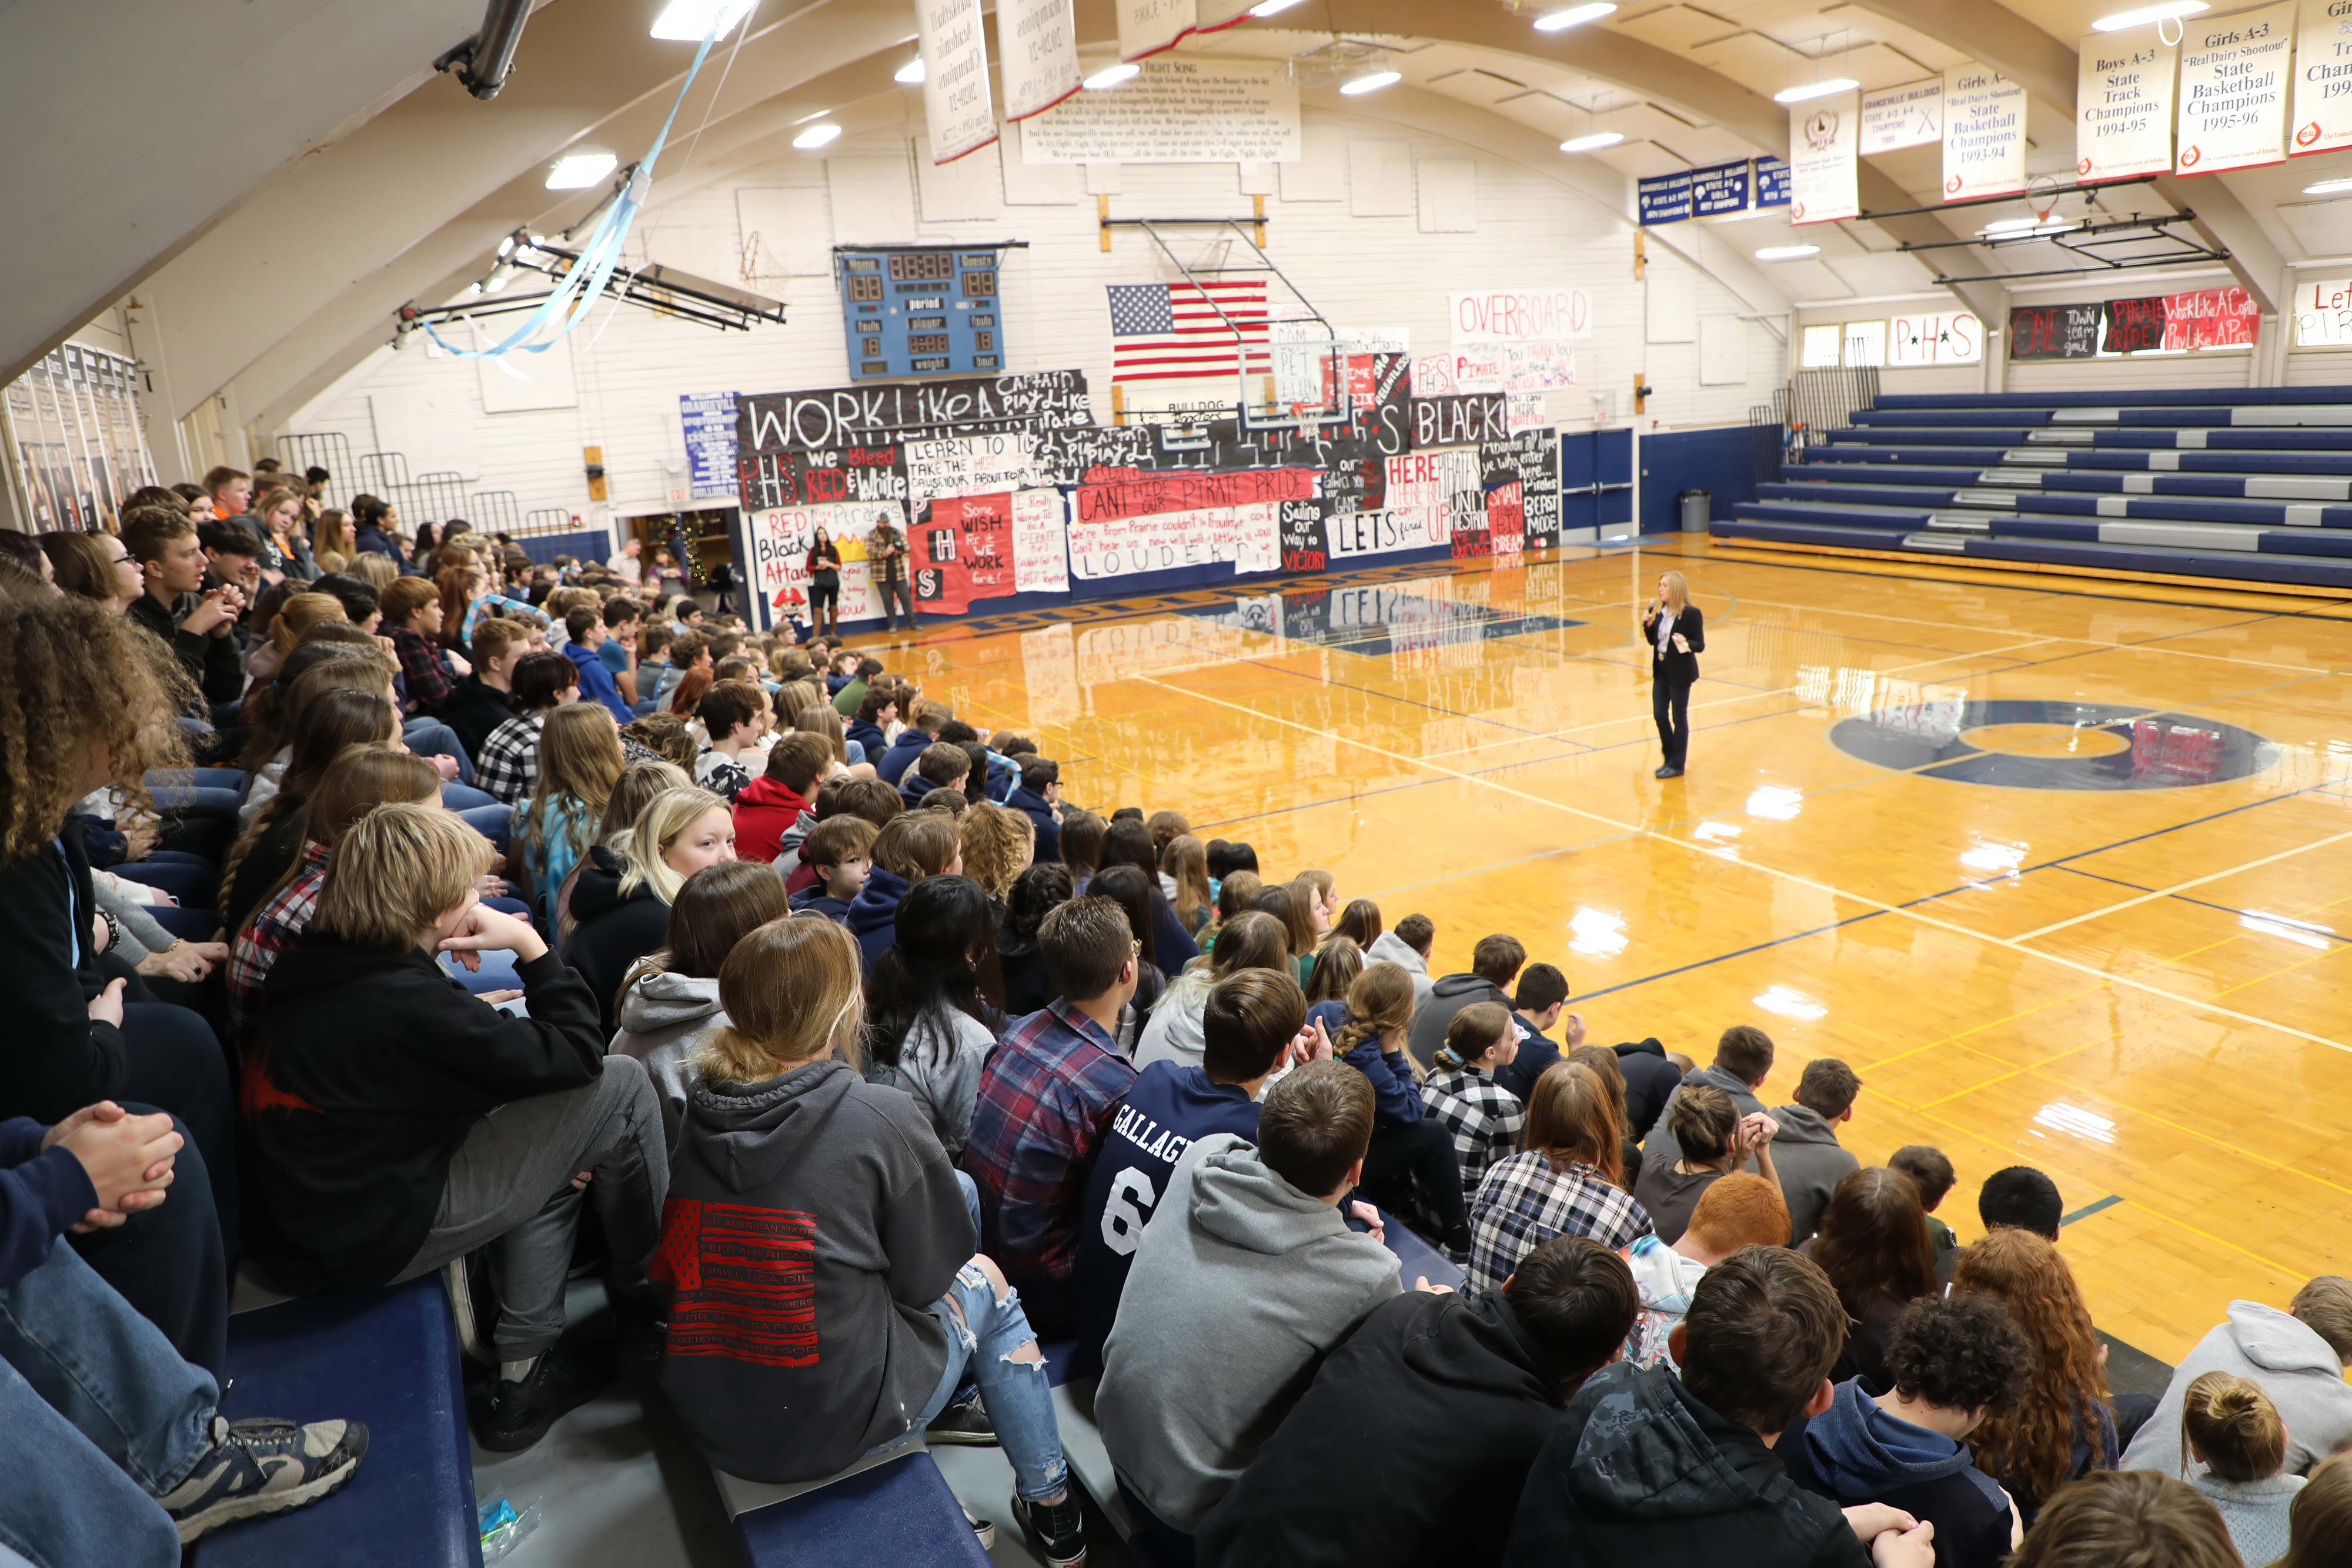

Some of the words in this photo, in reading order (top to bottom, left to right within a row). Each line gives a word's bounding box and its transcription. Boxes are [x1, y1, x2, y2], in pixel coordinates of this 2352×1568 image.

[2205, 31, 2241, 48] Girls
[2244, 23, 2269, 40] A-3
[2096, 59, 2125, 73] Boys
[2131, 49, 2155, 64] A-3
[2211, 49, 2237, 63] Dairy
[1173, 61, 1198, 73] SONG
[2214, 62, 2253, 79] State
[1958, 76, 1987, 90] Girls
[1992, 72, 2012, 85] A-
[2106, 73, 2140, 88] State
[2193, 72, 2274, 99] Basketball
[2104, 87, 2140, 104] Track
[2188, 92, 2275, 115] Champions
[1970, 105, 1999, 116] State
[2086, 101, 2159, 121] Champions
[1954, 113, 2016, 135] Basketball
[2095, 118, 2146, 138] 1994-95
[2203, 111, 2259, 131] 1995-96
[1950, 131, 2017, 149] Champions
[1961, 147, 2005, 163] 1993-94
[910, 297, 940, 310] period
[1459, 290, 1586, 339] OVERBOARD
[2013, 309, 2059, 355] ONE
[1526, 342, 1555, 359] THINK
[1457, 357, 1500, 379] PIRATE
[1169, 401, 1224, 412] BULLDOG
[749, 389, 885, 450] WORK
[1418, 396, 1506, 444] BLACK!
[848, 444, 894, 466] Bleed
[915, 437, 973, 460] LEARN
[984, 436, 1004, 455] TO
[1519, 449, 1545, 466] enter
[910, 462, 940, 477] TAKE
[946, 459, 967, 472] THE
[1389, 453, 1439, 484] HERE
[806, 468, 847, 504] RED
[856, 466, 907, 502] White
[1133, 480, 1171, 499] HIDE
[1182, 474, 1244, 509] PIRATE
[1255, 470, 1302, 500] PRIDE
[963, 502, 995, 517] Some
[1141, 496, 1167, 514] OUR
[1282, 501, 1321, 523] Sailing
[1524, 495, 1558, 517] BEAST
[769, 511, 807, 537] RED
[961, 515, 1001, 533] WISH
[1294, 520, 1315, 534] our
[1339, 510, 1396, 552] LETS
[1496, 515, 1523, 534] BIG
[1527, 514, 1558, 536] MODE
[759, 534, 811, 562] Black
[1308, 533, 1318, 546] to
[973, 544, 995, 556] WE
[1084, 542, 1222, 576] LOUDER
[964, 555, 1004, 570] WORK
[1282, 550, 1326, 571] VICTORY
[1101, 1166, 1155, 1256] 6
[703, 1217, 722, 1225] BUY
[725, 1220, 779, 1232] AMERICAN
[782, 1226, 816, 1236] MADE
[739, 1248, 812, 1259] AMERICAN
[703, 1267, 743, 1279] DRILL
[783, 1274, 811, 1283] OIL
[774, 1323, 814, 1332] FLAG
[780, 1346, 817, 1354] GOD
